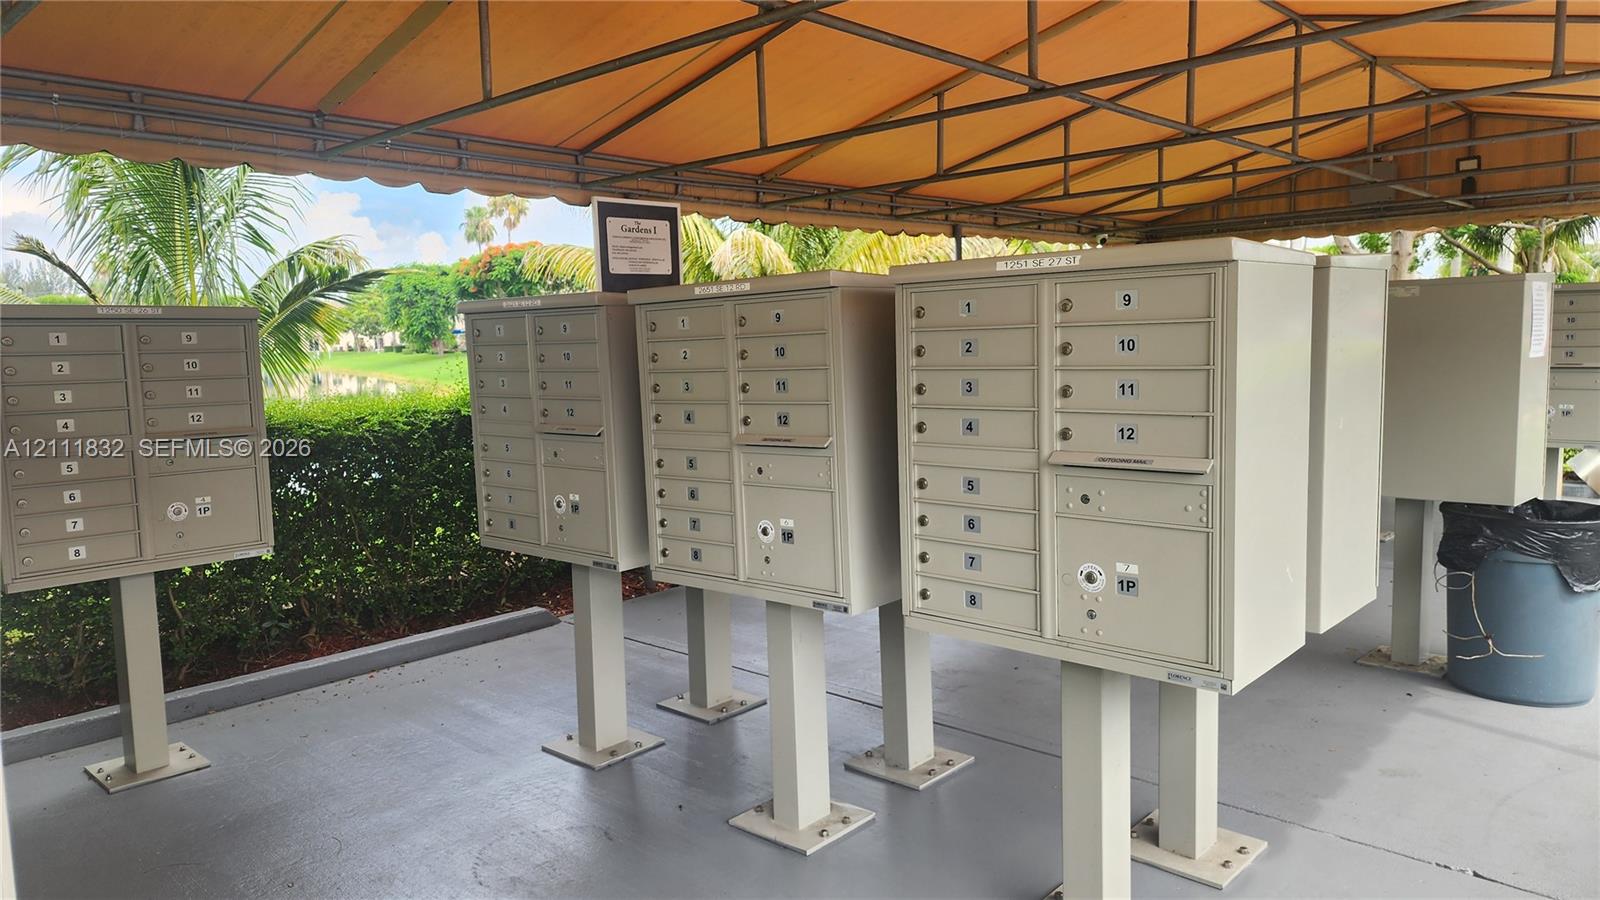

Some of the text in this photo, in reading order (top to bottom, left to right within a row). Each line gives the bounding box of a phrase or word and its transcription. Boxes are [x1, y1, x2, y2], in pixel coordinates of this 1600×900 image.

[620, 224, 652, 234] Gardens
[1004, 256, 1076, 269] 1251 SE 27 ST
[1122, 294, 1132, 306] 9
[966, 302, 970, 314] 1
[775, 312, 781, 322] 9
[681, 318, 685, 328] 1
[54, 336, 60, 344] 1
[185, 334, 192, 342] 9
[966, 342, 972, 352] 2
[1118, 338, 1136, 352] 10
[682, 350, 688, 360] 2
[774, 346, 785, 356] 10
[57, 364, 65, 372] 2
[565, 380, 572, 388] 11
[684, 382, 690, 392] 3
[776, 380, 786, 390] 11
[966, 382, 972, 392] 3
[187, 388, 199, 396] 11
[1120, 384, 1134, 396] 11
[59, 392, 67, 402] 3
[566, 408, 575, 416] 12
[190, 414, 202, 422] 12
[686, 414, 692, 422] 4
[777, 416, 788, 424] 12
[62, 422, 69, 430] 4
[966, 422, 974, 432] 4
[1118, 428, 1134, 440] 12
[66, 464, 74, 472] 5
[688, 458, 694, 468] 5
[968, 480, 974, 492] 5
[68, 492, 76, 502] 6
[689, 490, 696, 500] 6
[198, 506, 210, 514] 1P
[570, 504, 580, 514] 1P
[71, 520, 78, 530] 7
[691, 520, 697, 530] 7
[968, 518, 974, 530] 6
[781, 532, 794, 542] 1P
[73, 548, 81, 558] 8
[693, 550, 699, 560] 8
[968, 556, 976, 566] 7
[1118, 580, 1136, 592] 1P
[970, 594, 976, 606] 8
